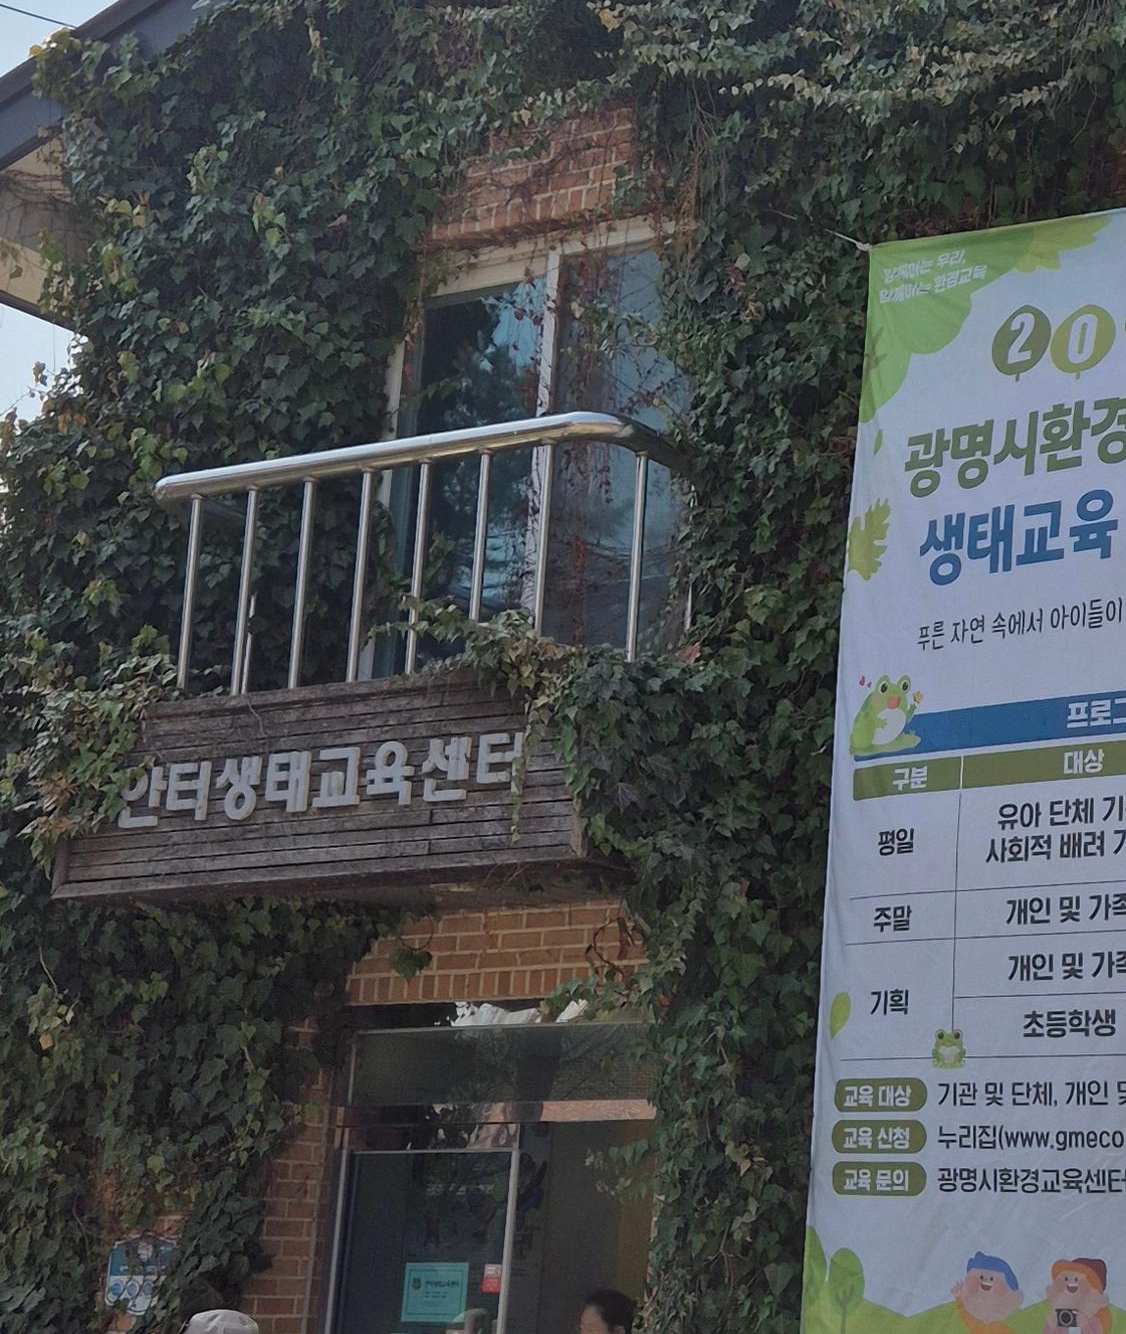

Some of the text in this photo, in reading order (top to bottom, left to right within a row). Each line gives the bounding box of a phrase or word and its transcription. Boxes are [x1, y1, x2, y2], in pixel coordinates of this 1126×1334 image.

[934, 265, 987, 294] 환경교육
[919, 489, 1119, 586] 생태교육
[917, 620, 945, 651] 푸른
[950, 615, 985, 644] 자연
[991, 608, 1043, 639] 속에서
[1050, 597, 1123, 630] 아이들이
[1063, 749, 1105, 775] 대상
[118, 731, 525, 829] 안터생태교육센터
[892, 766, 928, 791] 구분
[998, 802, 1041, 830] 유아
[1049, 797, 1095, 826] 단체
[877, 828, 915, 857] 평일
[985, 835, 1051, 864] 사회적
[1060, 830, 1105, 859] 배려
[873, 904, 912, 933] 주말
[1005, 896, 1050, 925] 개인
[1058, 895, 1081, 923] 및
[1008, 953, 1054, 982] 개인
[1061, 952, 1083, 980] 및
[870, 989, 909, 1016] 기획
[1023, 1008, 1117, 1039] 초등학생
[843, 1085, 912, 1107] 교육 대상
[938, 1082, 978, 1107] 기관
[985, 1082, 1004, 1107] 및
[1012, 1081, 1058, 1108] 단체,
[1065, 1080, 1109, 1106] 개인
[843, 1126, 910, 1149] 교육 신청
[843, 1169, 909, 1192] 교육 문의
